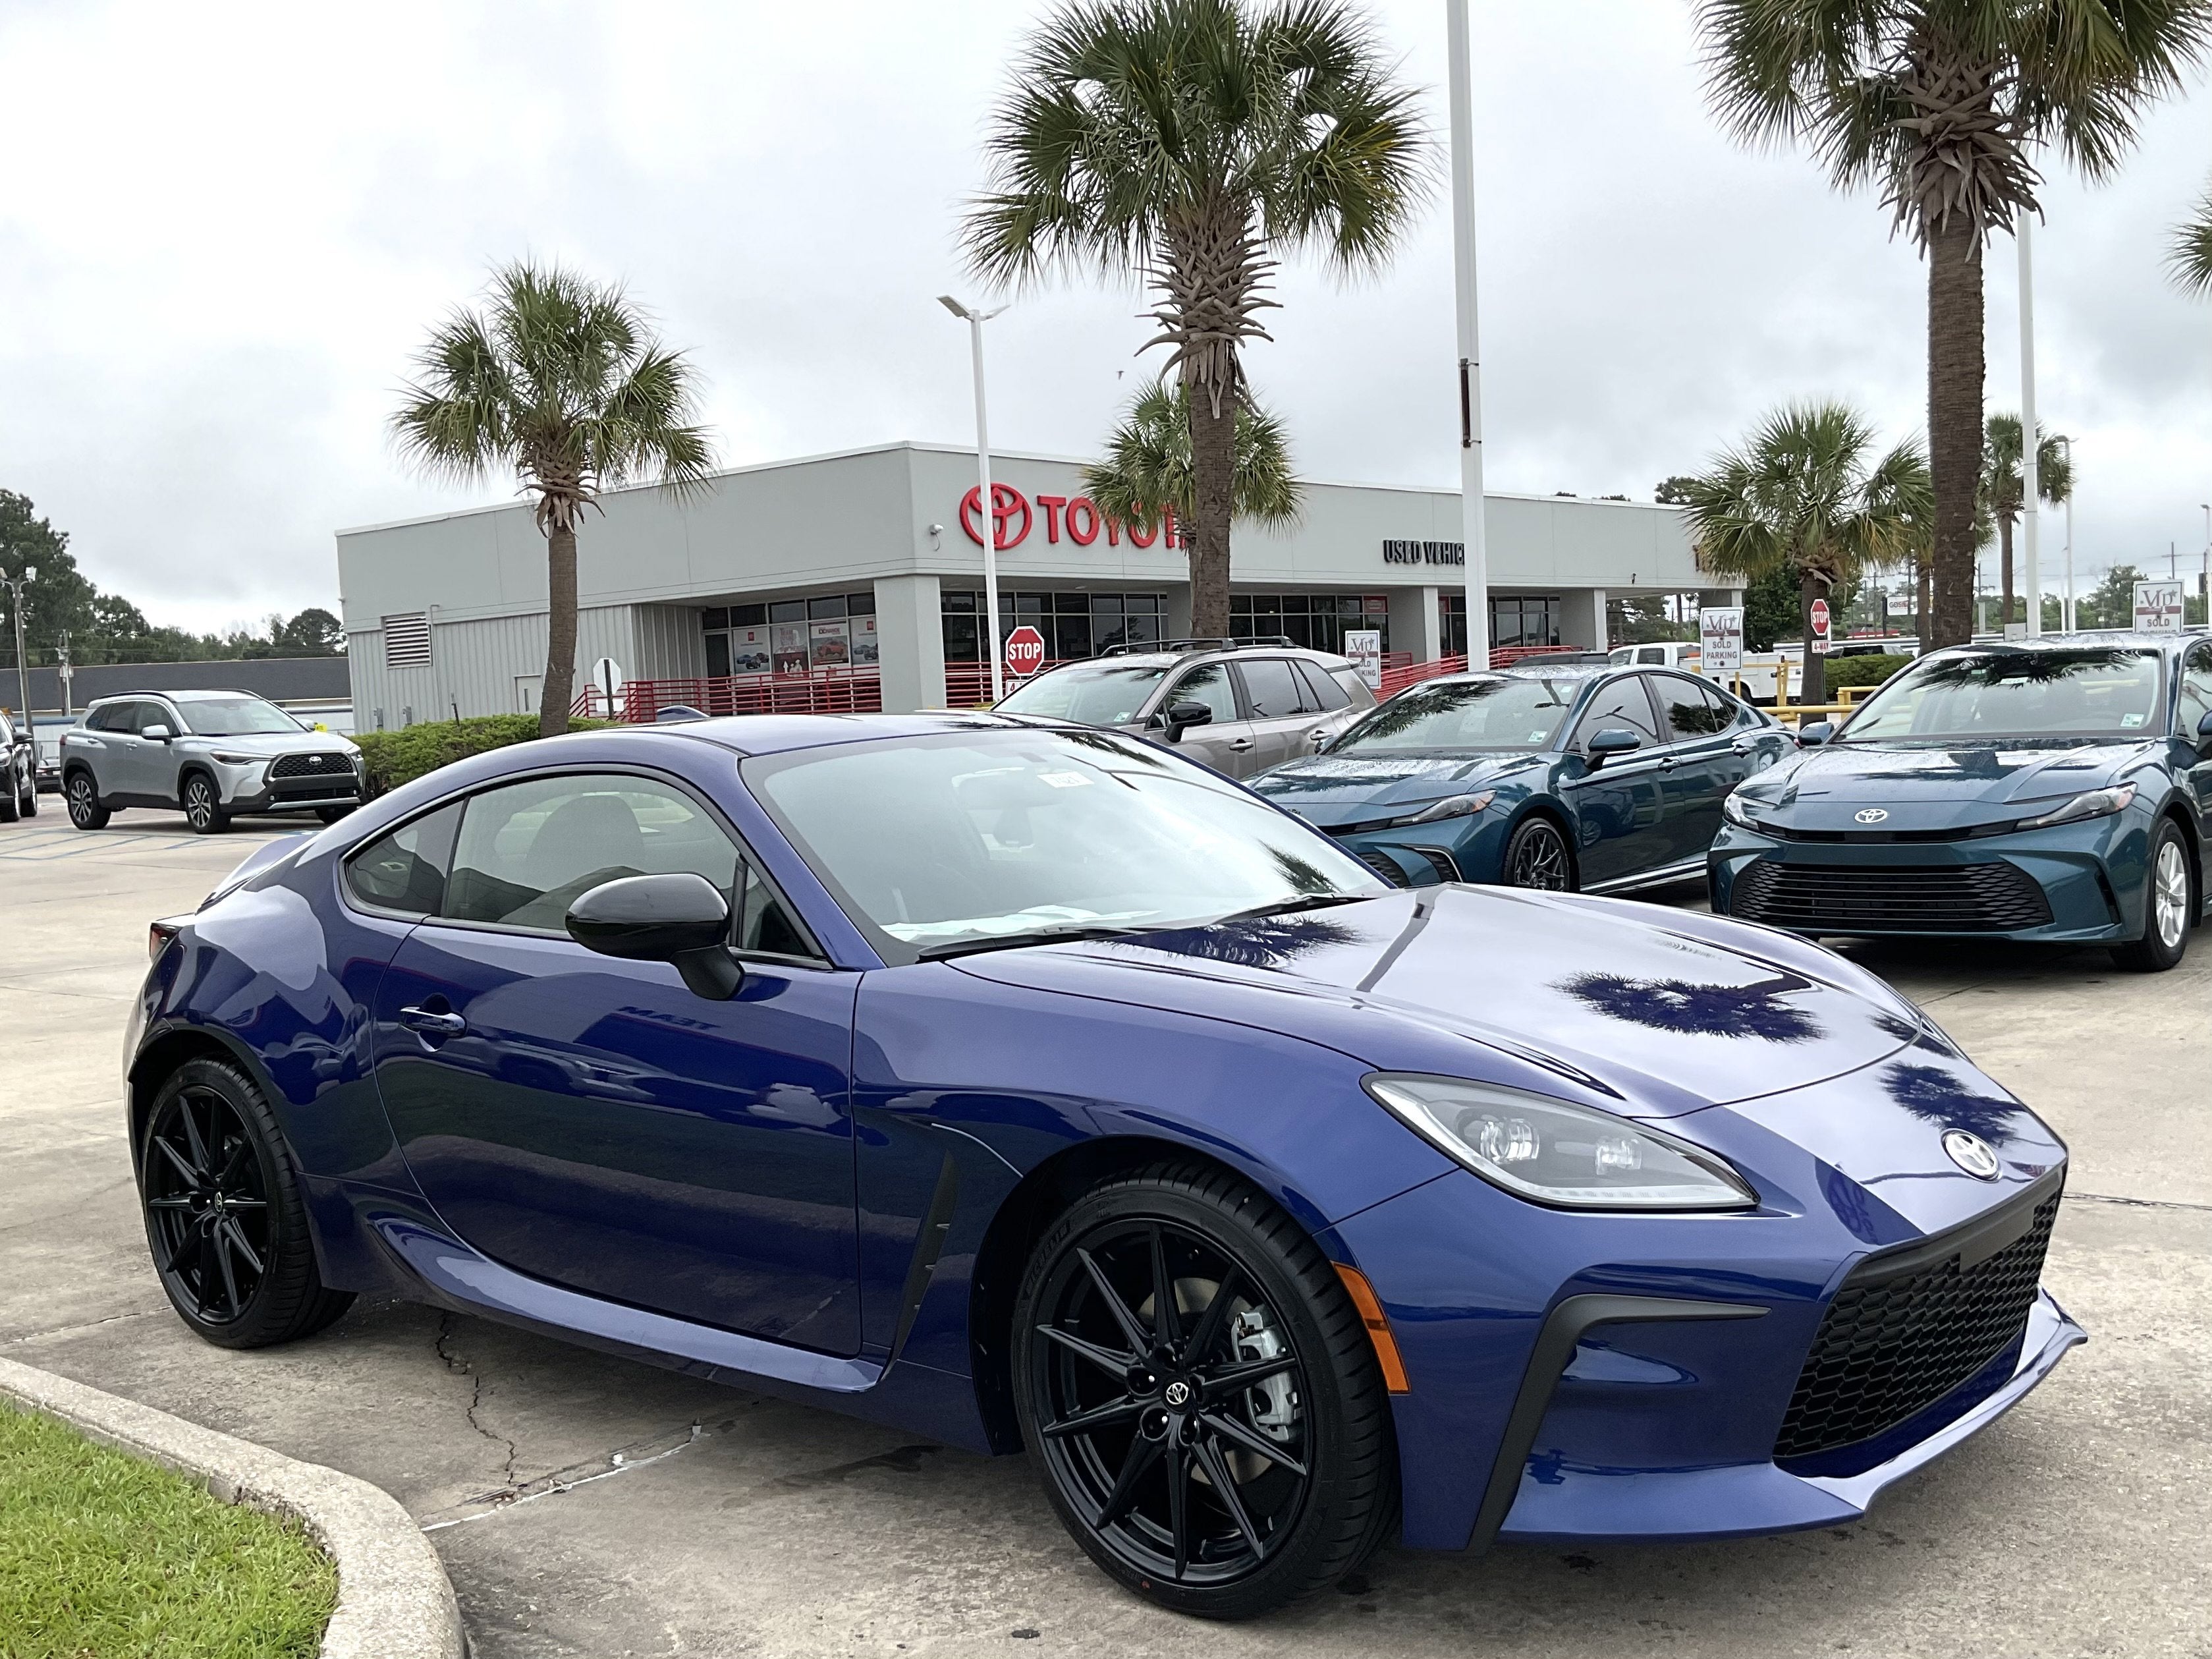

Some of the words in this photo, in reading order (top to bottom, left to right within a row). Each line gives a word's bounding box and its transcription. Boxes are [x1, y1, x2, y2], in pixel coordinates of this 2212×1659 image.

[1037, 495, 1186, 549] TOYOT
[1383, 540, 1422, 563] USED
[1422, 541, 1465, 565] VEHIC
[1812, 611, 1828, 624] STOP
[2147, 618, 2170, 627] SOLD
[1009, 642, 1041, 660] STOP
[1813, 642, 1829, 651] 4-WAY
[1706, 651, 1738, 660] PARKING
